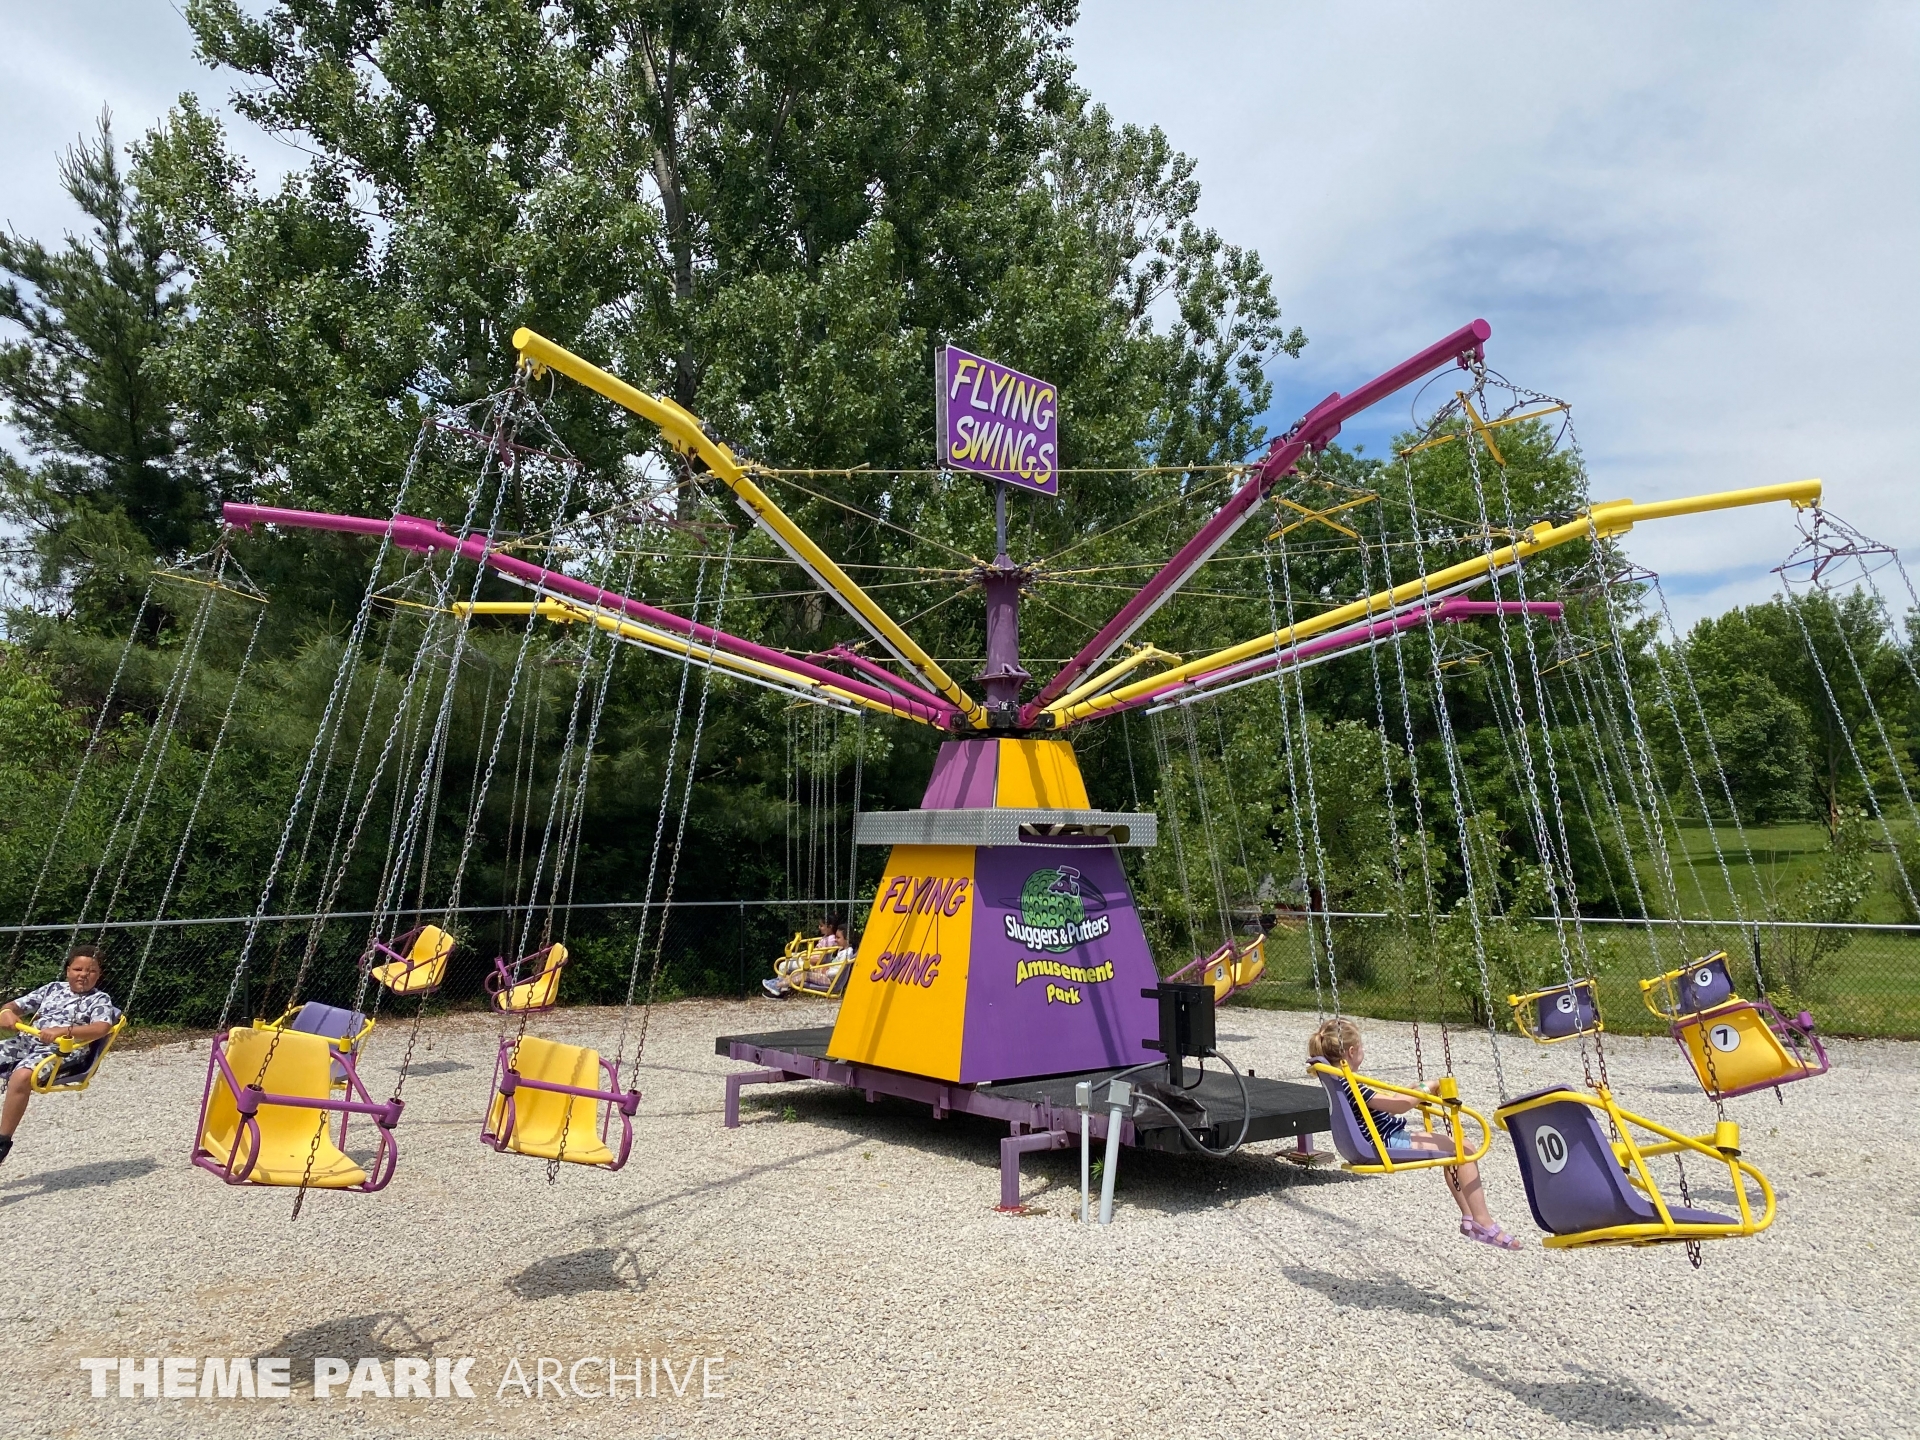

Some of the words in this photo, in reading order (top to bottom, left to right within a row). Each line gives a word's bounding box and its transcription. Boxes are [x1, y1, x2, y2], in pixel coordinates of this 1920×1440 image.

[950, 359, 1054, 431] FLYING
[951, 415, 1055, 484] SWINGS
[879, 875, 970, 917] FLYING
[1005, 915, 1059, 950] Sluggers
[1059, 928, 1068, 945] &
[1066, 915, 1109, 944] Putters
[870, 951, 942, 988] SWING
[1016, 959, 1114, 986] Amusement
[1699, 970, 1709, 983] 6
[1046, 983, 1081, 1005] Park
[1562, 997, 1571, 1010] 5
[1715, 1028, 1728, 1046] 7
[1537, 1132, 1564, 1164] 10
